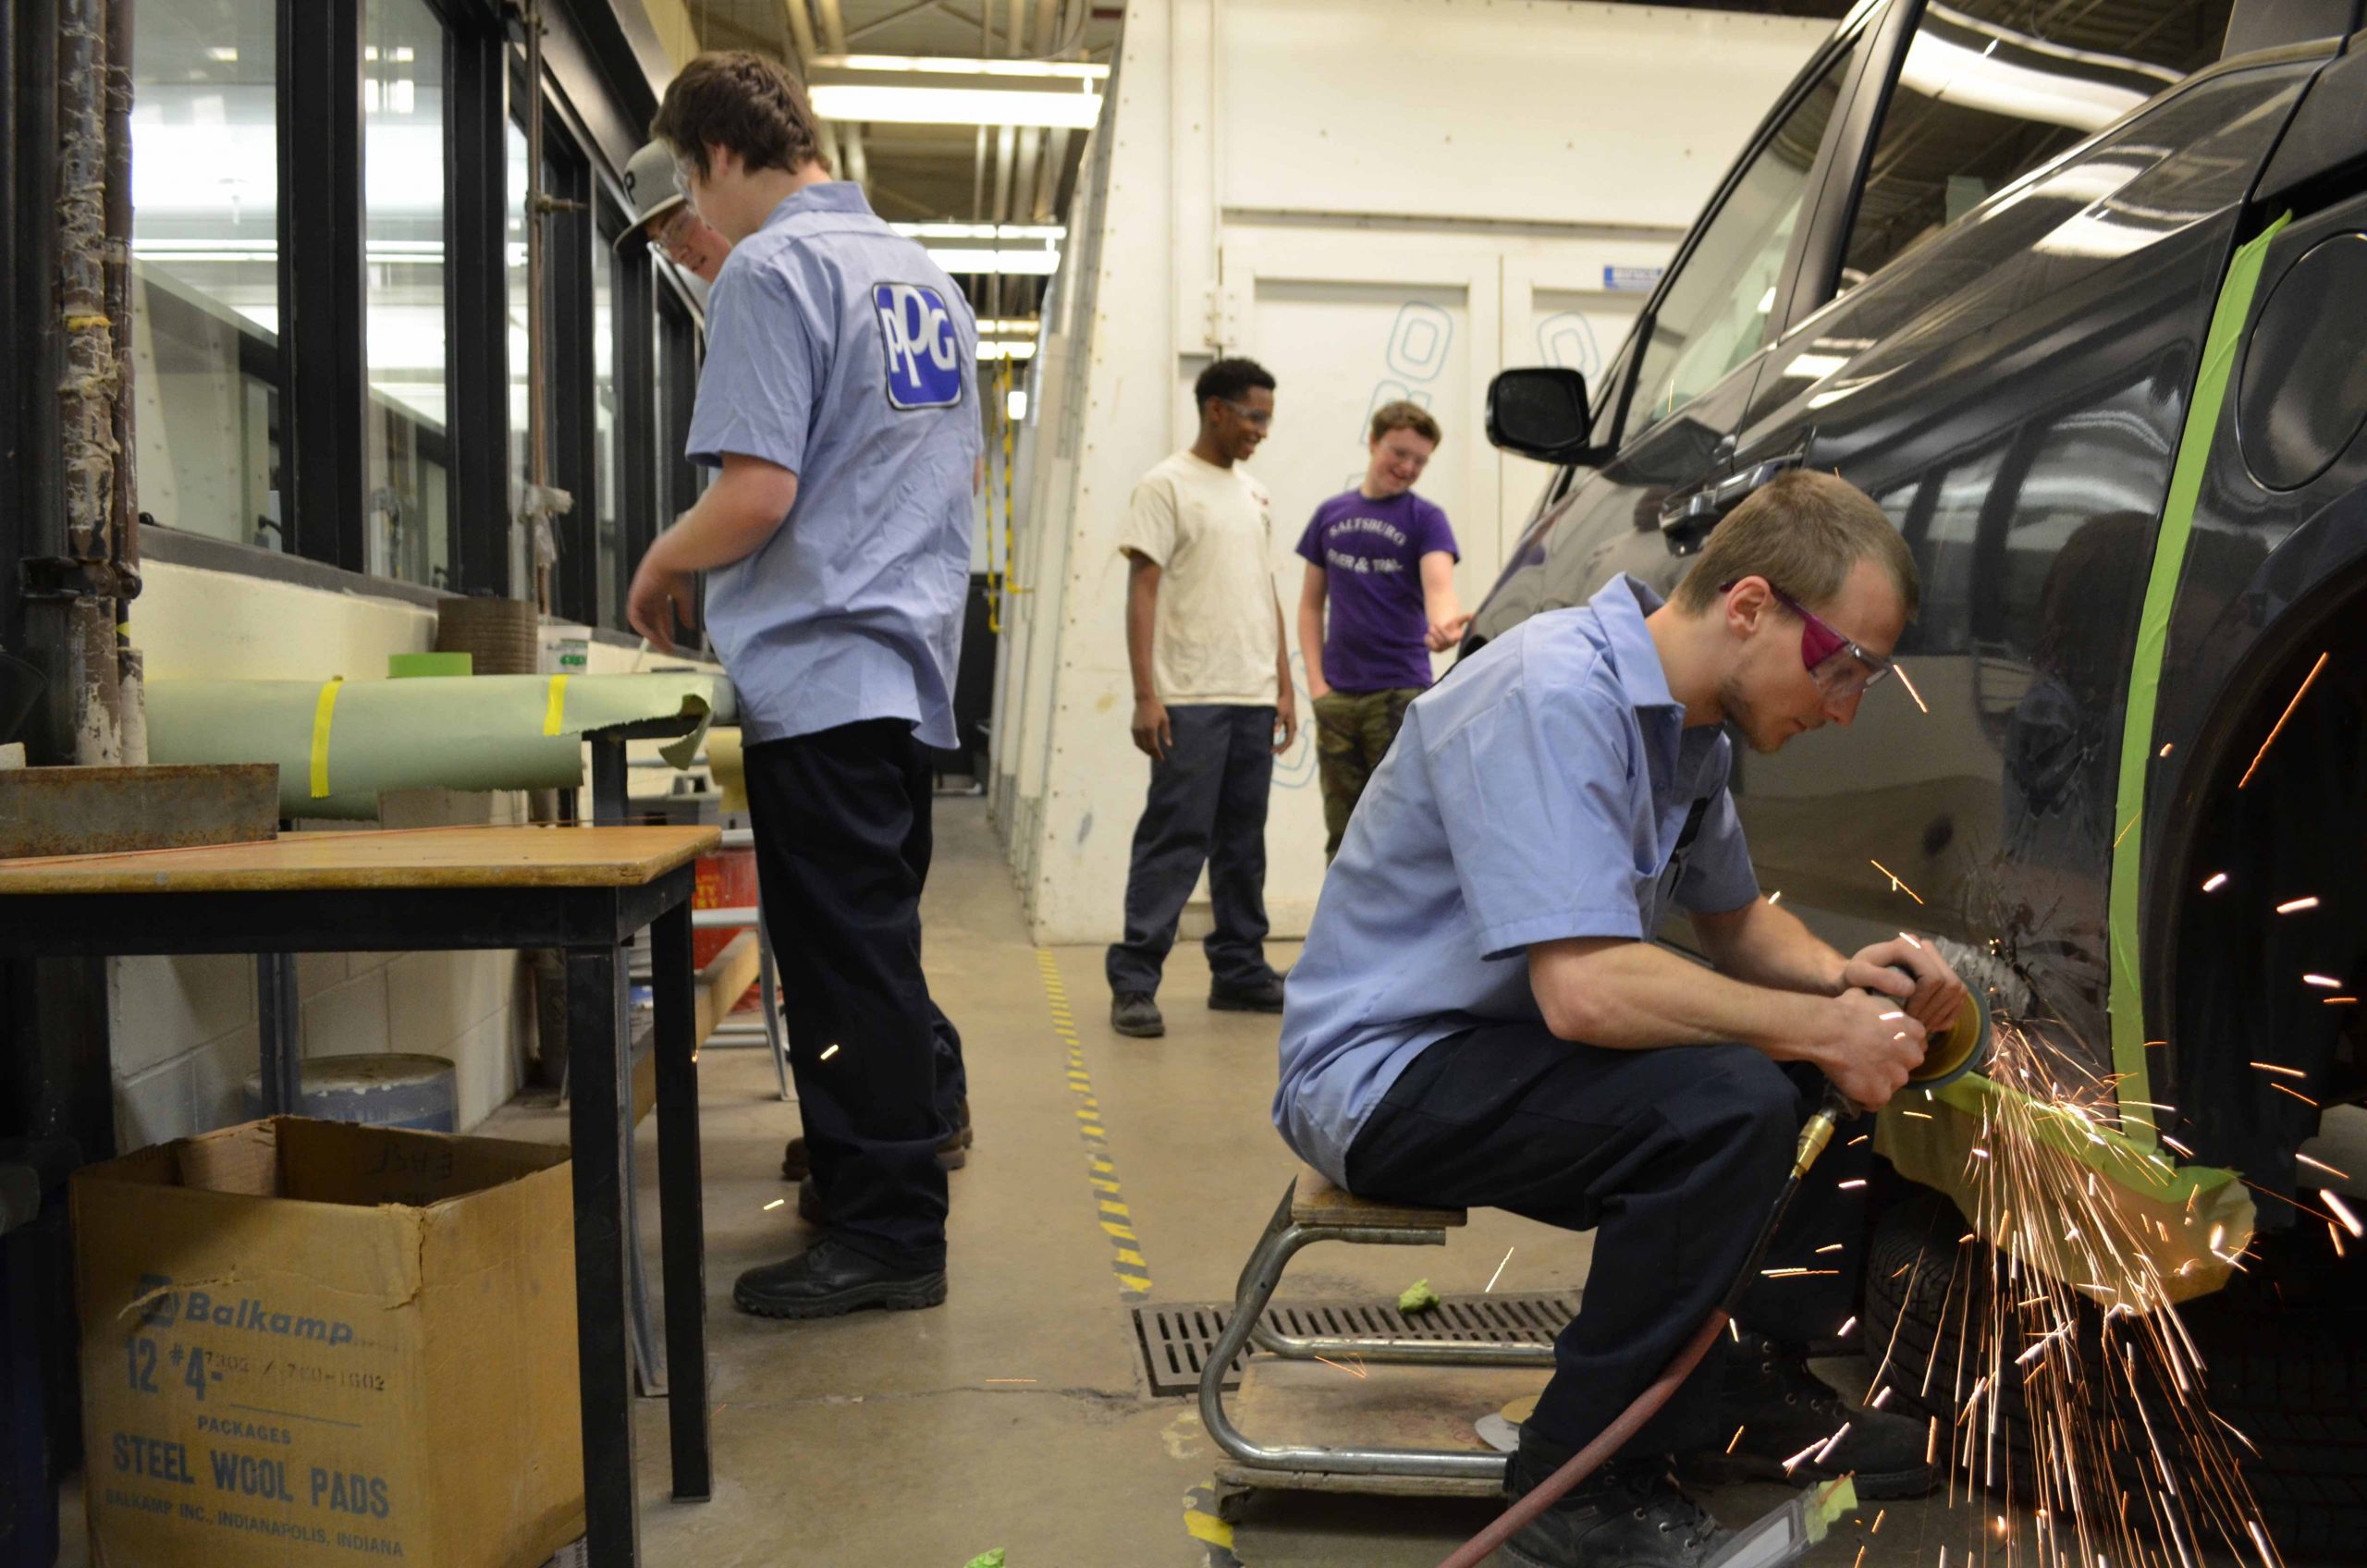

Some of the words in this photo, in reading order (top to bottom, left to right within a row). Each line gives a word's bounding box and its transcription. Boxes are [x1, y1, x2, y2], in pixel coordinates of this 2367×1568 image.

[878, 285, 958, 387] PPG
[1354, 557, 1368, 574] &
[186, 1292, 355, 1346] Balkamp
[125, 1337, 159, 1393] 12
[198, 1415, 292, 1445] PACKAGES
[113, 1431, 195, 1485] STEEL
[210, 1450, 294, 1502] WOOL
[311, 1467, 389, 1518] PADS
[104, 1488, 173, 1515] BALKAMP
[337, 1530, 404, 1557] INDIANA
